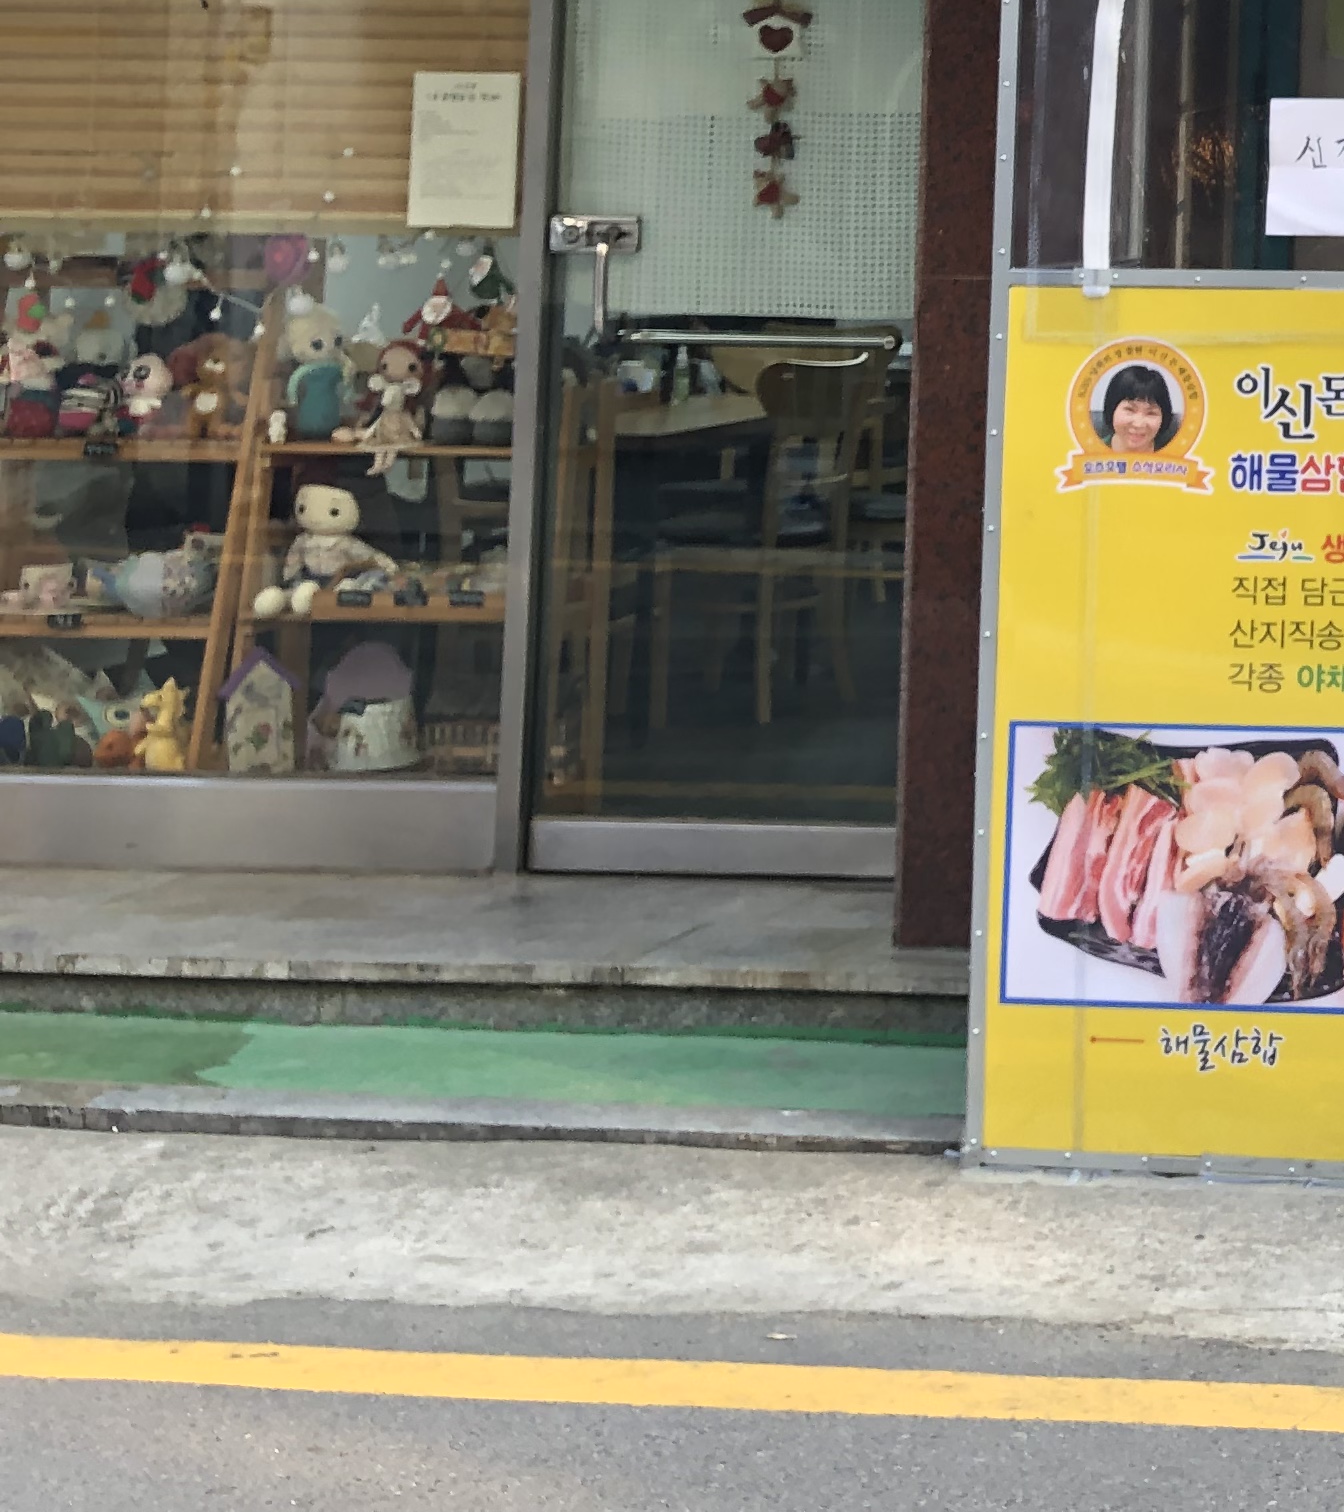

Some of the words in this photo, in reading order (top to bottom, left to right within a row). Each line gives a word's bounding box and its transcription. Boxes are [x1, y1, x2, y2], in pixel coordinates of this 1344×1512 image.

[1247, 528, 1305, 562] Jeju
[1231, 575, 1288, 606] 직접
[1227, 661, 1286, 694] 각종
[1159, 1023, 1284, 1072] 해물삼합
